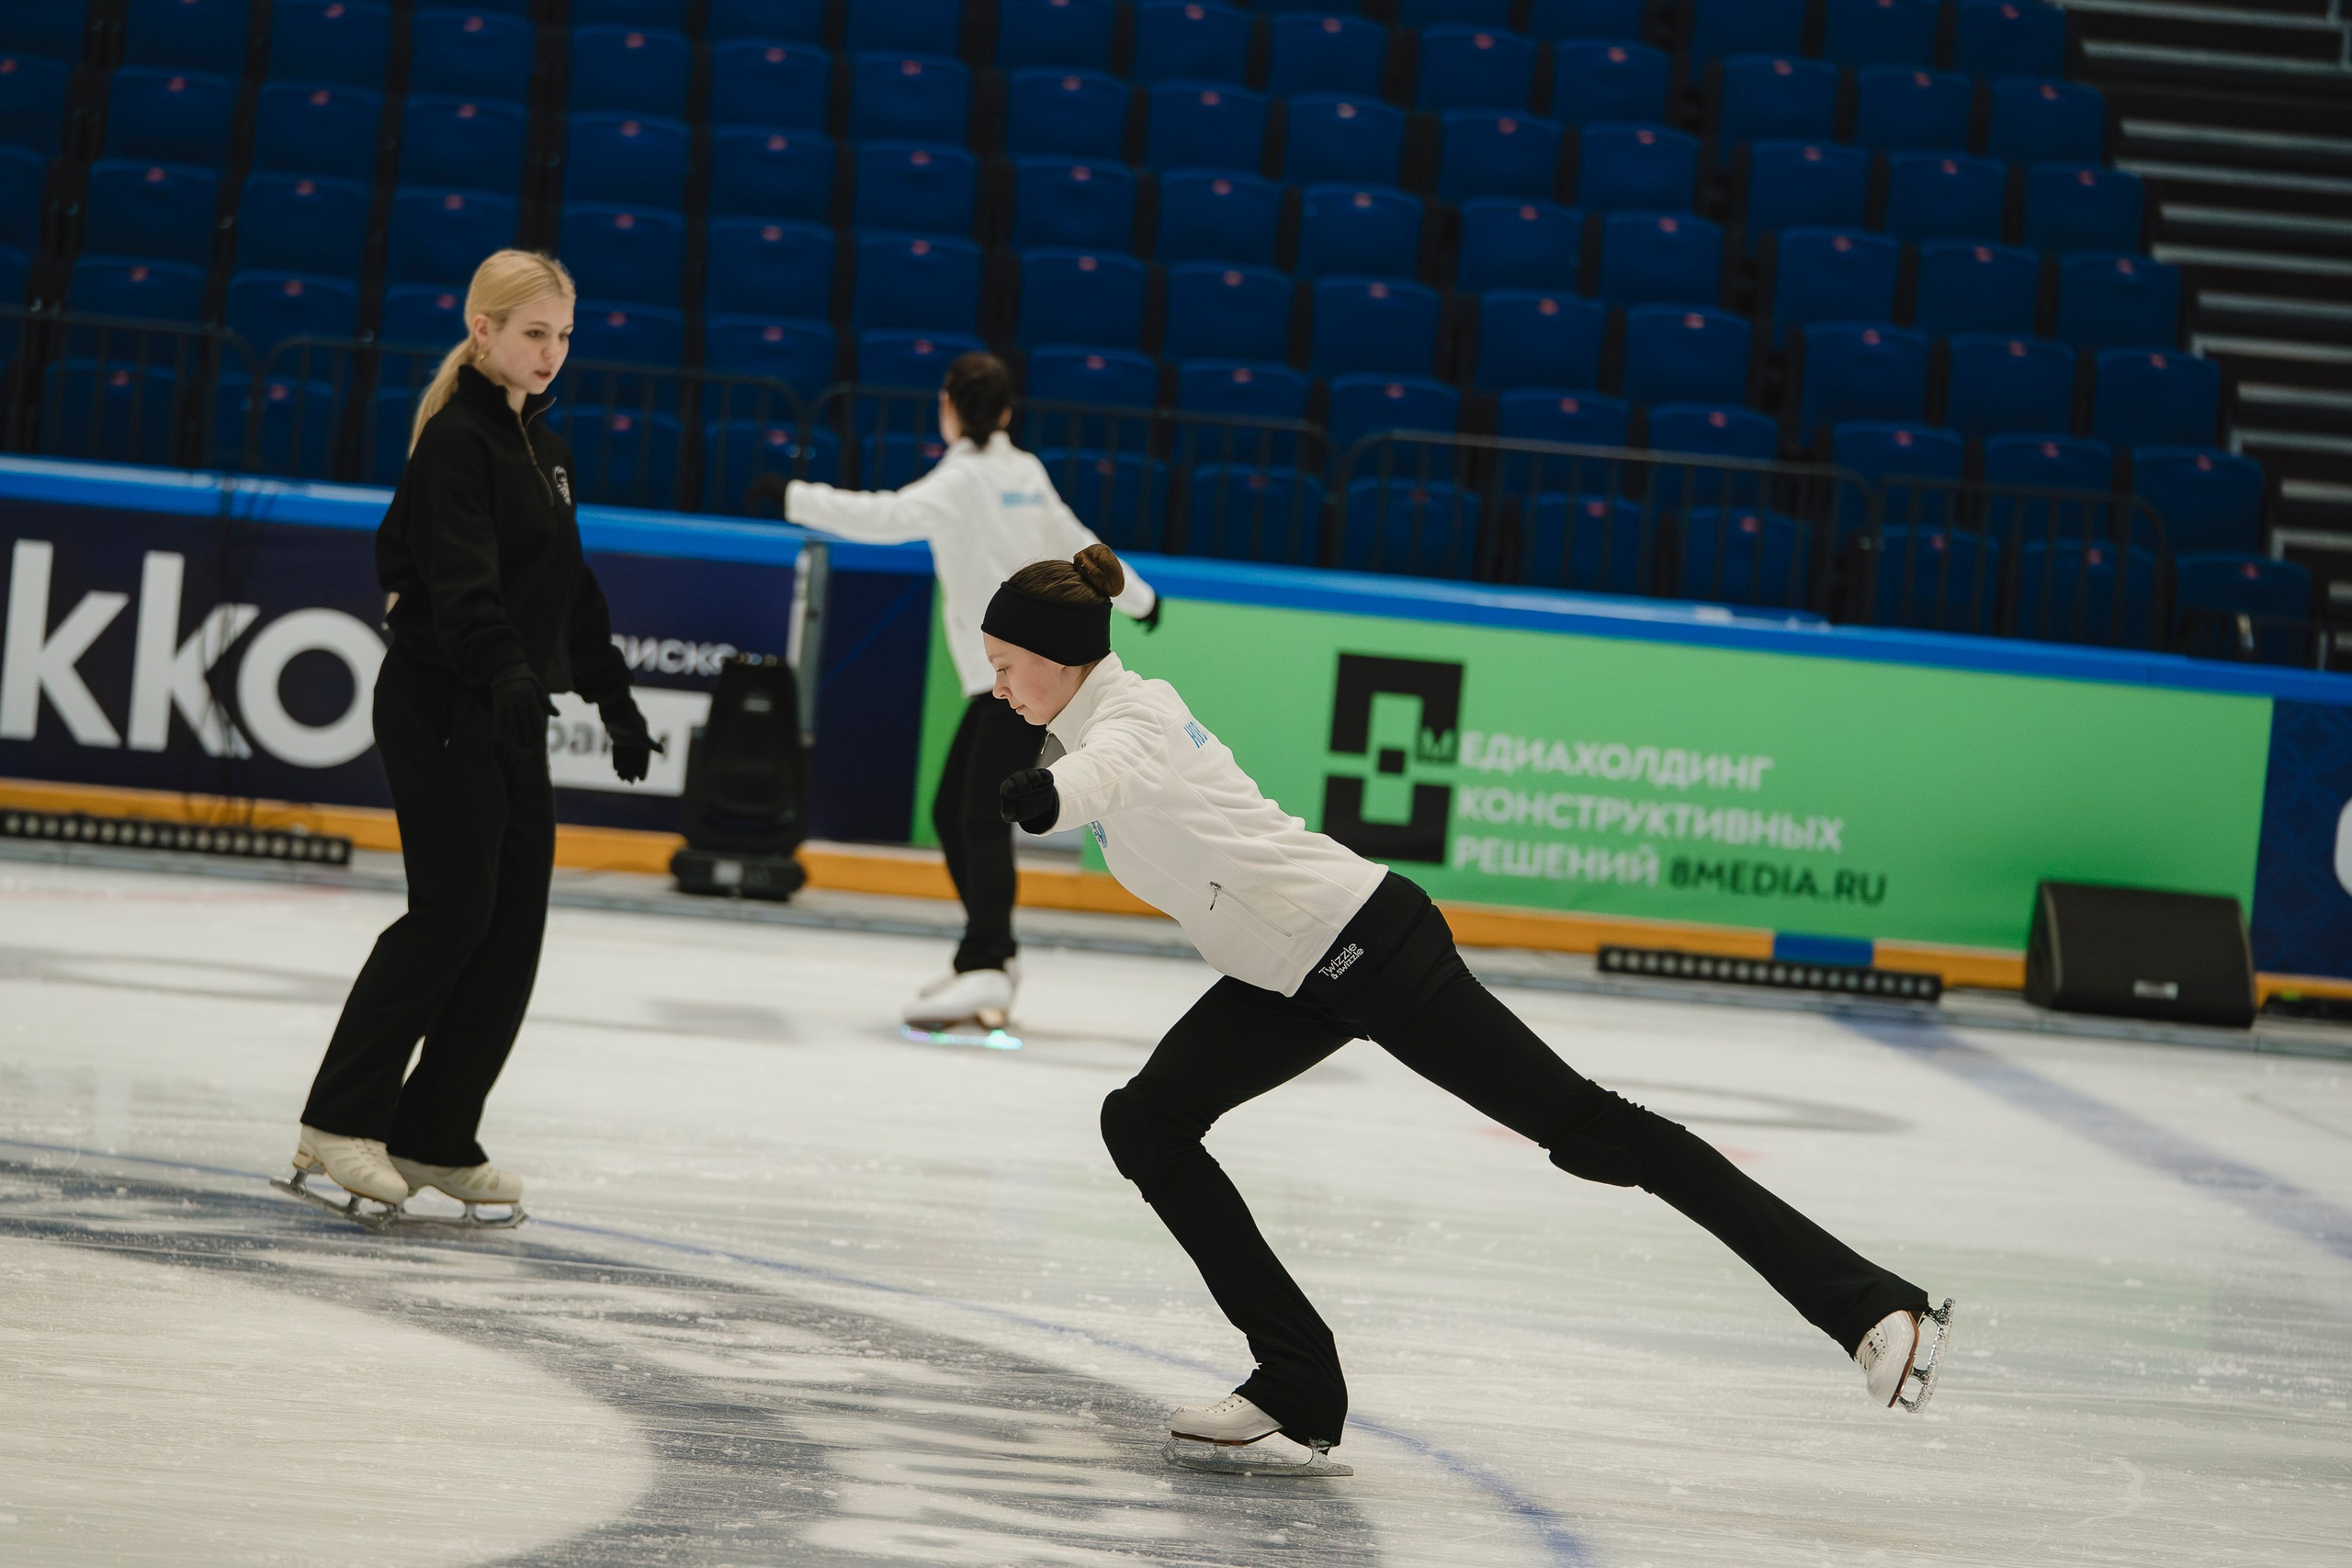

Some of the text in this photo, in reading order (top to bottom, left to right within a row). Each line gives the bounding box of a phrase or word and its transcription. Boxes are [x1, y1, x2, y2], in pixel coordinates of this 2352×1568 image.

[1418, 728, 1774, 792] МЕДИАХОЛДИНГ
[1457, 784, 1845, 854] КОНСТРУКТИВНЫХ
[1453, 834, 1888, 906] РЕШЕНИЙ 8MEDIA.RU
[1317, 942, 1358, 976] Twizzle
